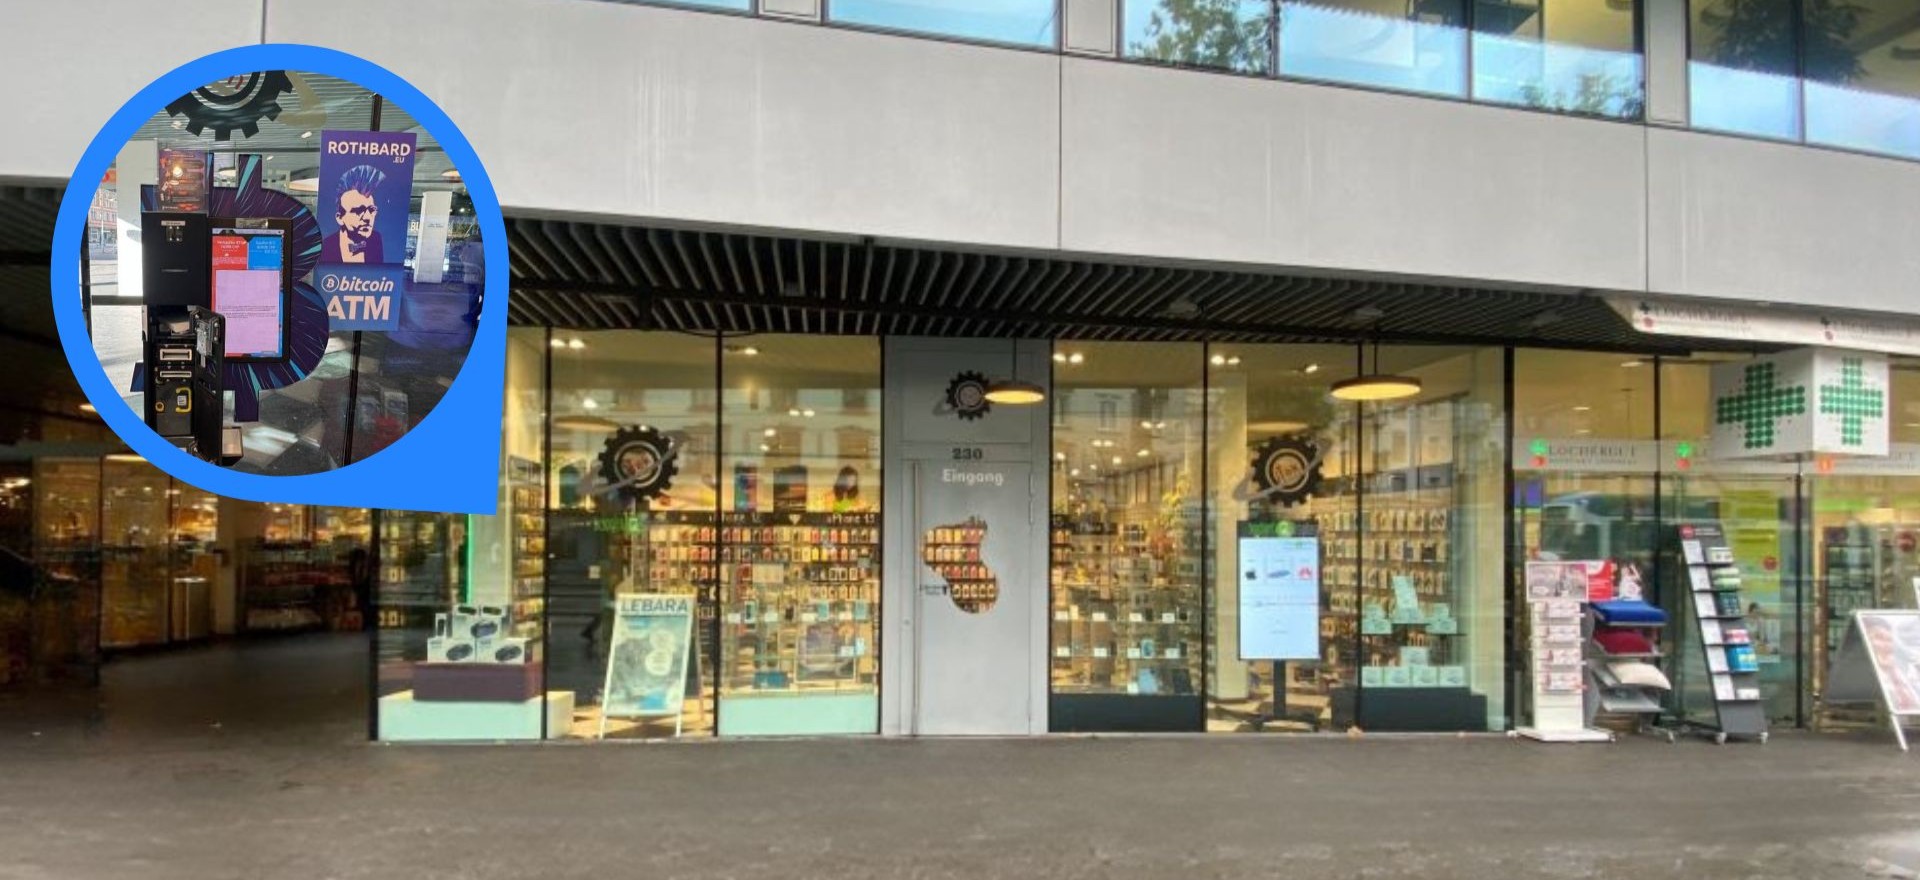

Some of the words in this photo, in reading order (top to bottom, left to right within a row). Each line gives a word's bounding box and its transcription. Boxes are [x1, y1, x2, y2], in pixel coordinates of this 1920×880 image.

[328, 141, 411, 156] ROTHBARD
[339, 275, 394, 292] bitcoin
[327, 295, 391, 320] ATM
[952, 447, 983, 460] 230
[943, 468, 1005, 487] Eingang
[621, 598, 689, 612] LEBARA
